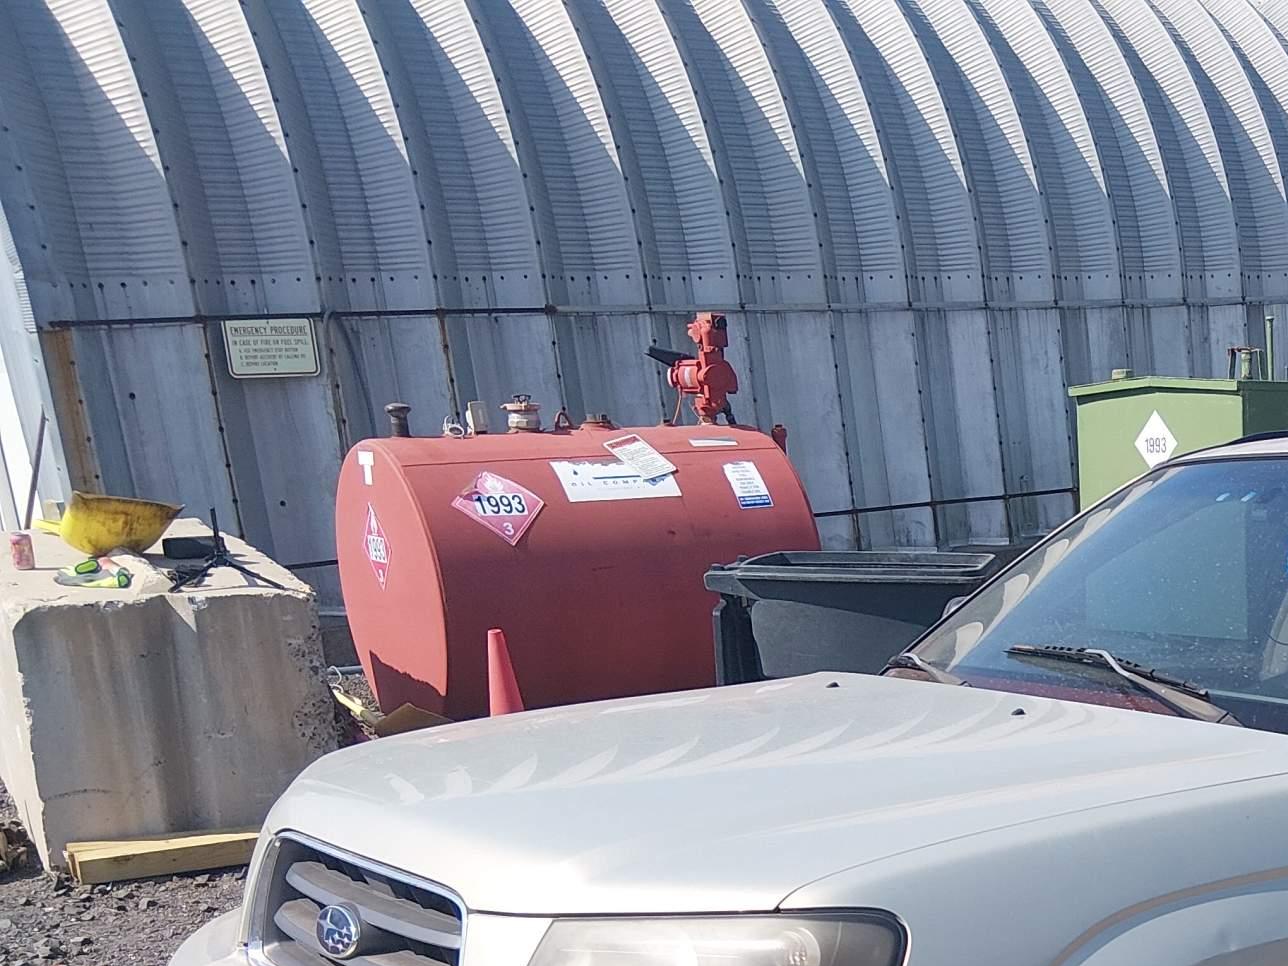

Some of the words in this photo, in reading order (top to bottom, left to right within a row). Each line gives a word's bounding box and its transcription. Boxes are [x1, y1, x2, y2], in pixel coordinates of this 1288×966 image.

[230, 326, 267, 335] EMERGENCY
[270, 325, 308, 335] PROCEDURE
[1144, 437, 1167, 453] 1993
[474, 494, 526, 515] 1993
[502, 522, 514, 535] 3
